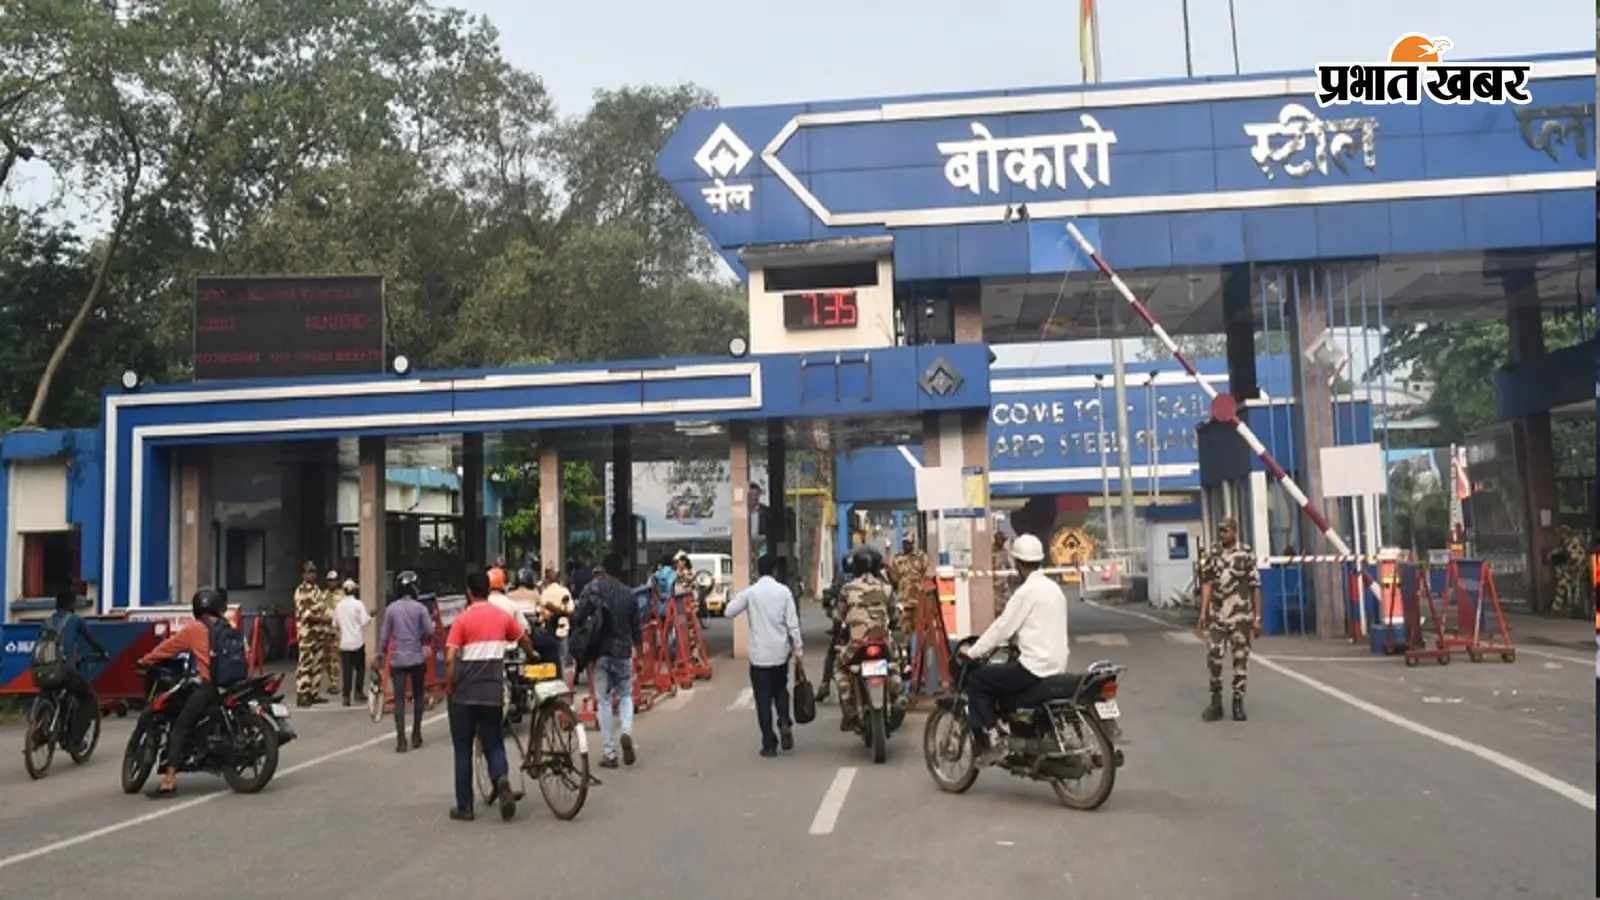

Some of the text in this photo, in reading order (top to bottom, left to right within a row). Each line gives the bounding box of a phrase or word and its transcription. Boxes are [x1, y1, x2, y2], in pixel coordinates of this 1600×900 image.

[937, 103, 1596, 194] बोकारो स्टील प्ल
[701, 179, 753, 213] सेल
